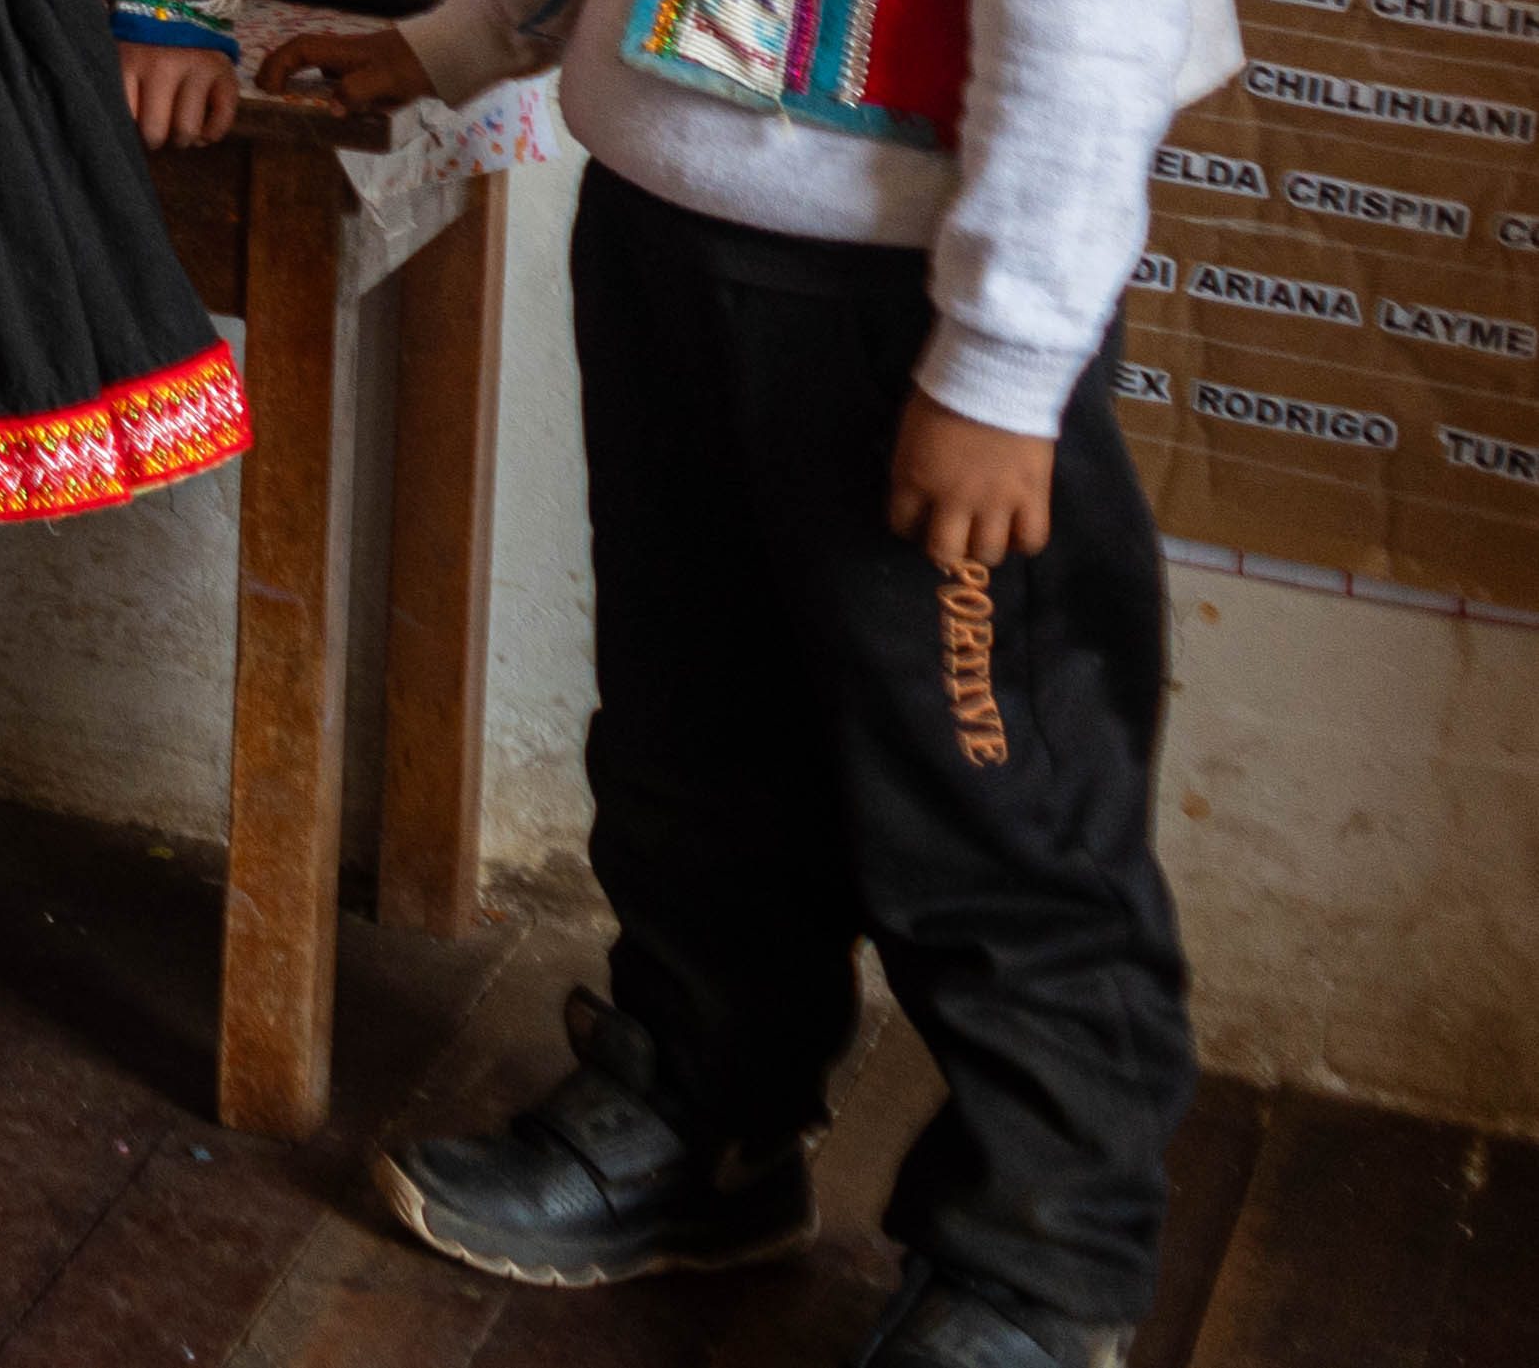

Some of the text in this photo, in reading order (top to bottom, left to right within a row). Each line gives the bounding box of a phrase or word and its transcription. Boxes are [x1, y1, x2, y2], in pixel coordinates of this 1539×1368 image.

[1248, 64, 1534, 143] CHILLIHUANI
[1152, 149, 1469, 239] ELDA CRISPIN
[1132, 255, 1536, 358] DI ARIANA LAYME
[1114, 366, 1170, 401] EX
[1197, 382, 1396, 449] RODRIGO
